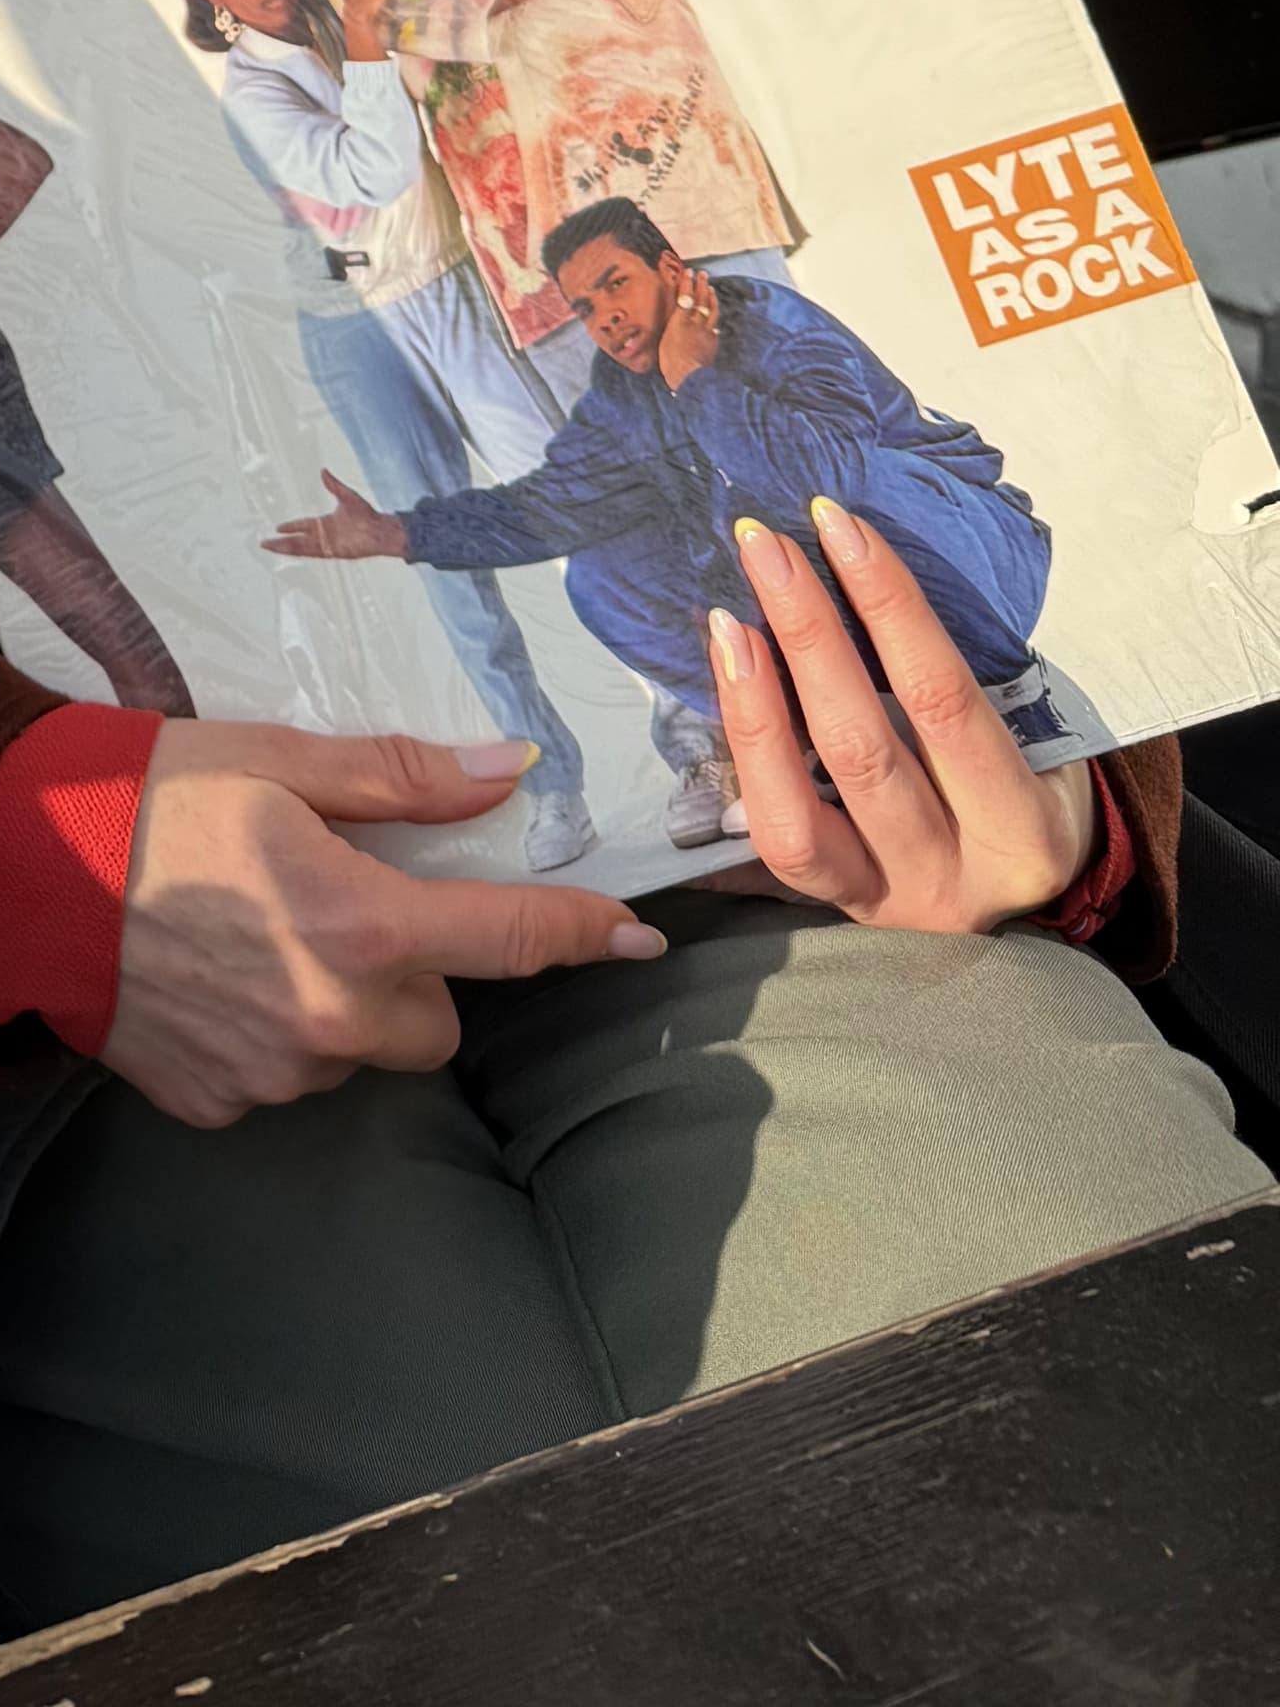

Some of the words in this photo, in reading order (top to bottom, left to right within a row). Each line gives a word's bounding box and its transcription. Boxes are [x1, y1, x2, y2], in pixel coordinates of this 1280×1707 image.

[931, 122, 1134, 232] LYTE
[969, 207, 1080, 277] AS
[1094, 187, 1153, 238] A
[973, 226, 1175, 329] ROCK
